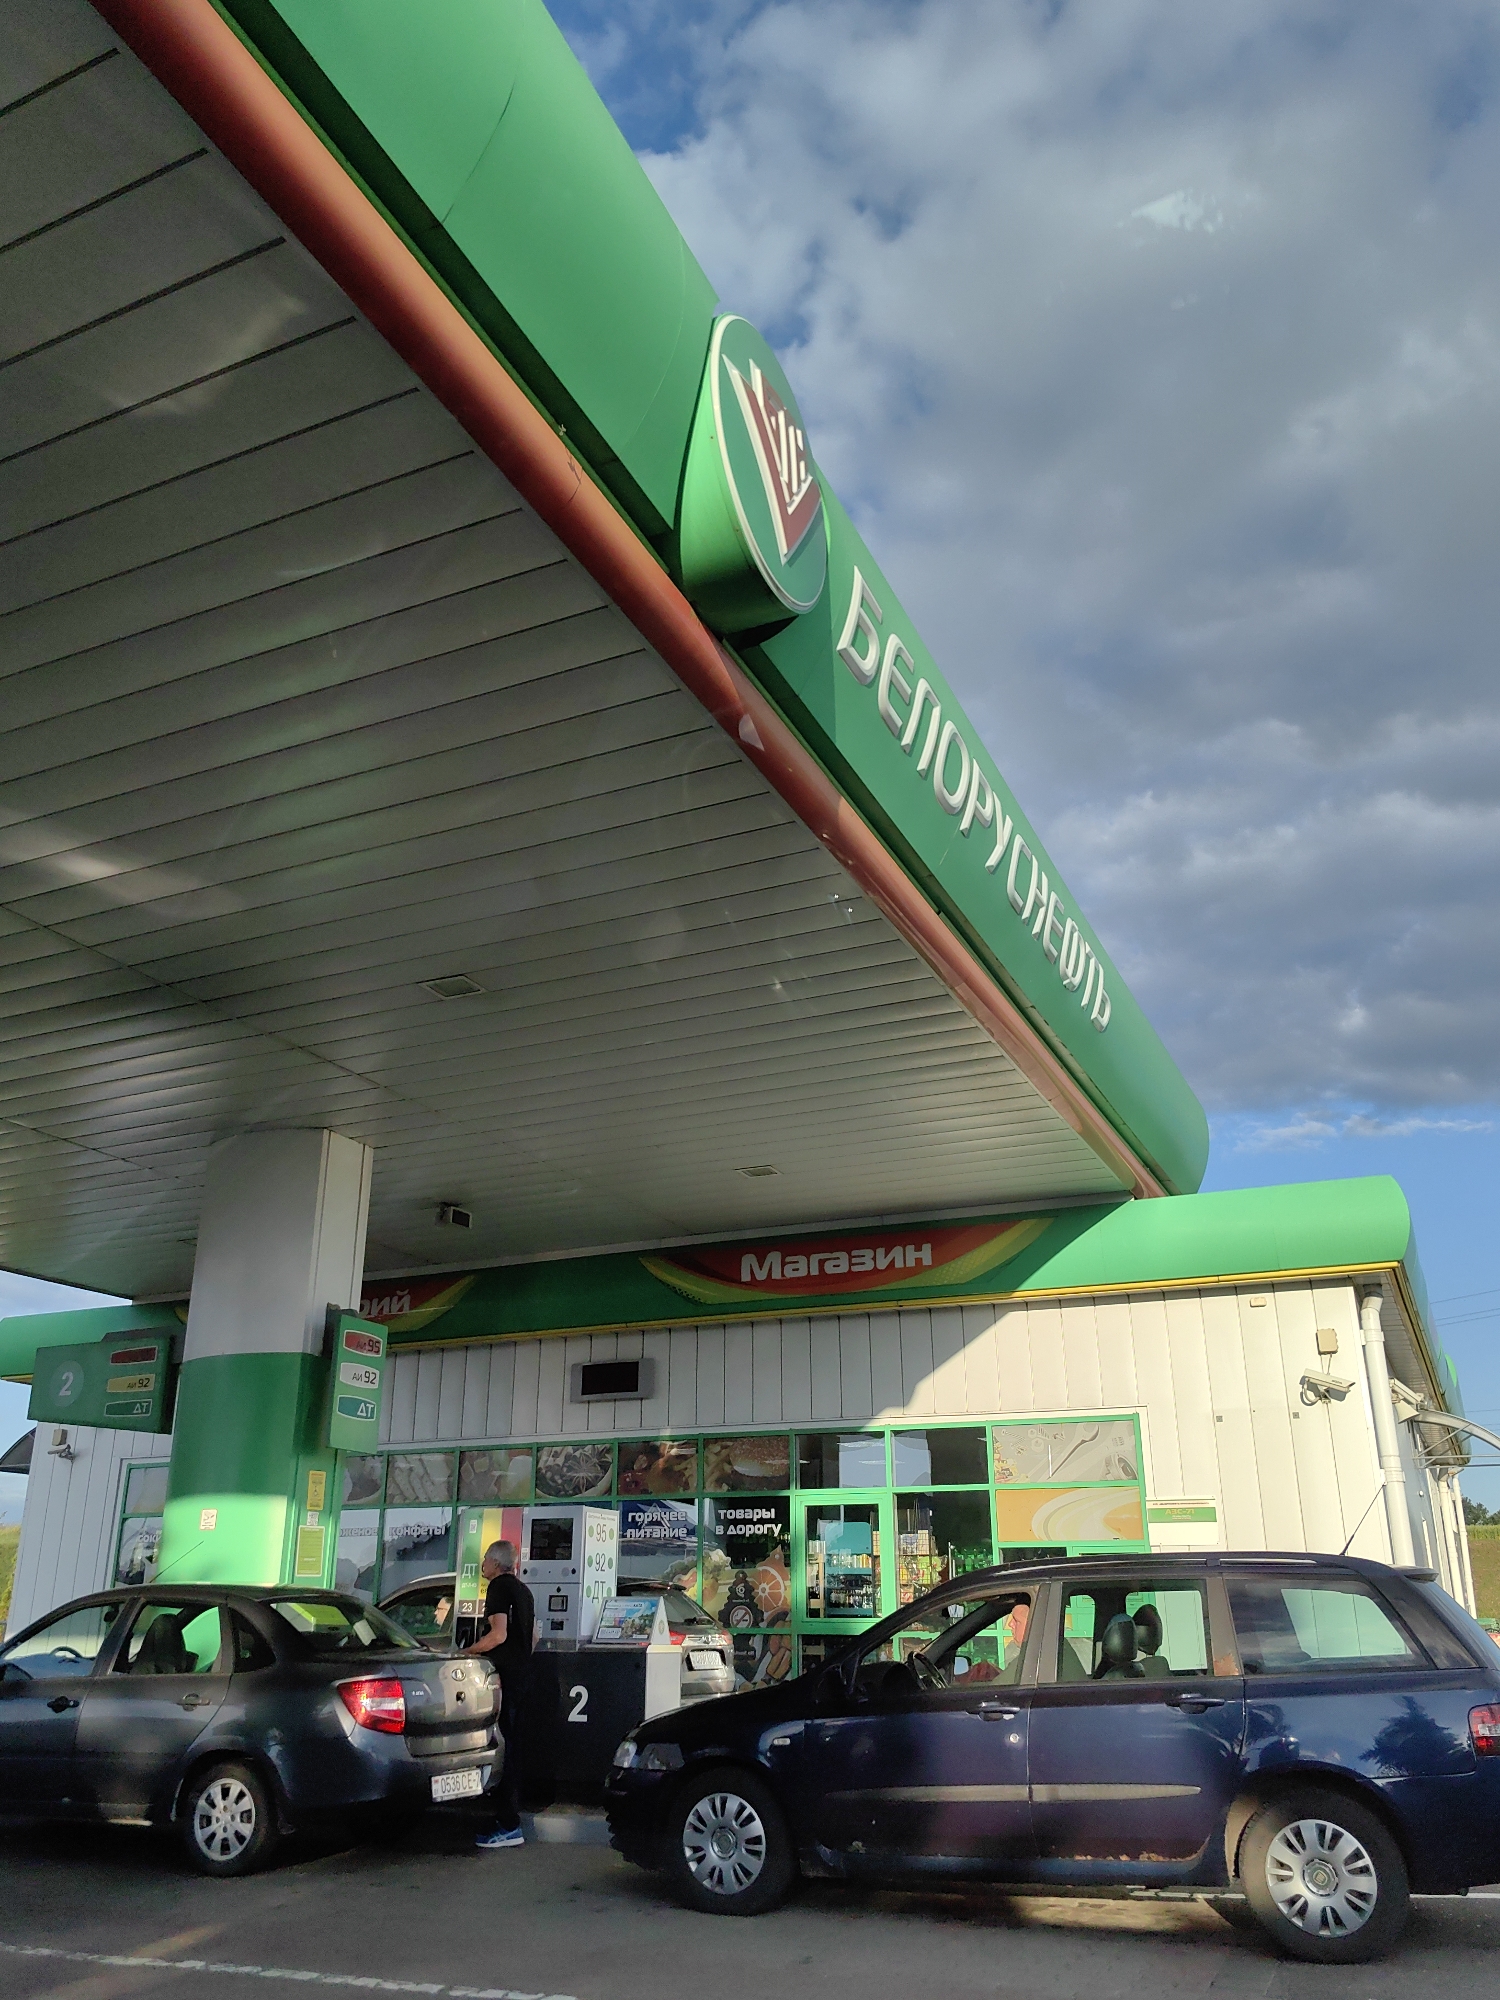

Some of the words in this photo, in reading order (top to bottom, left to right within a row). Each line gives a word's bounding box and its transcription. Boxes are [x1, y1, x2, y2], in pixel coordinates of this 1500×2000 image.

[836, 564, 1112, 1033] БЕЛОРУСНЕФТЬ
[740, 1243, 933, 1282] Магазин
[367, 1338, 381, 1353] 95
[58, 1371, 74, 1396] 2
[138, 1377, 150, 1388] 92
[352, 1372, 363, 1382] АИ
[364, 1370, 377, 1385] 92
[133, 1402, 149, 1414] ДТ
[357, 1402, 375, 1417] ДТ
[627, 1510, 687, 1523] горячее
[718, 1508, 776, 1522] товары
[389, 1524, 446, 1538] конфеты
[595, 1523, 607, 1543] 95
[626, 1526, 688, 1539] питание
[715, 1526, 724, 1535] в
[726, 1523, 782, 1538] дорогу
[594, 1552, 606, 1572] 92
[461, 1563, 478, 1579] ДТ
[592, 1580, 606, 1604] ДТ
[461, 1602, 473, 1612] 23
[567, 1685, 589, 1722] 2
[440, 1774, 461, 1794] 0536
[462, 1770, 480, 1790] CE-7
